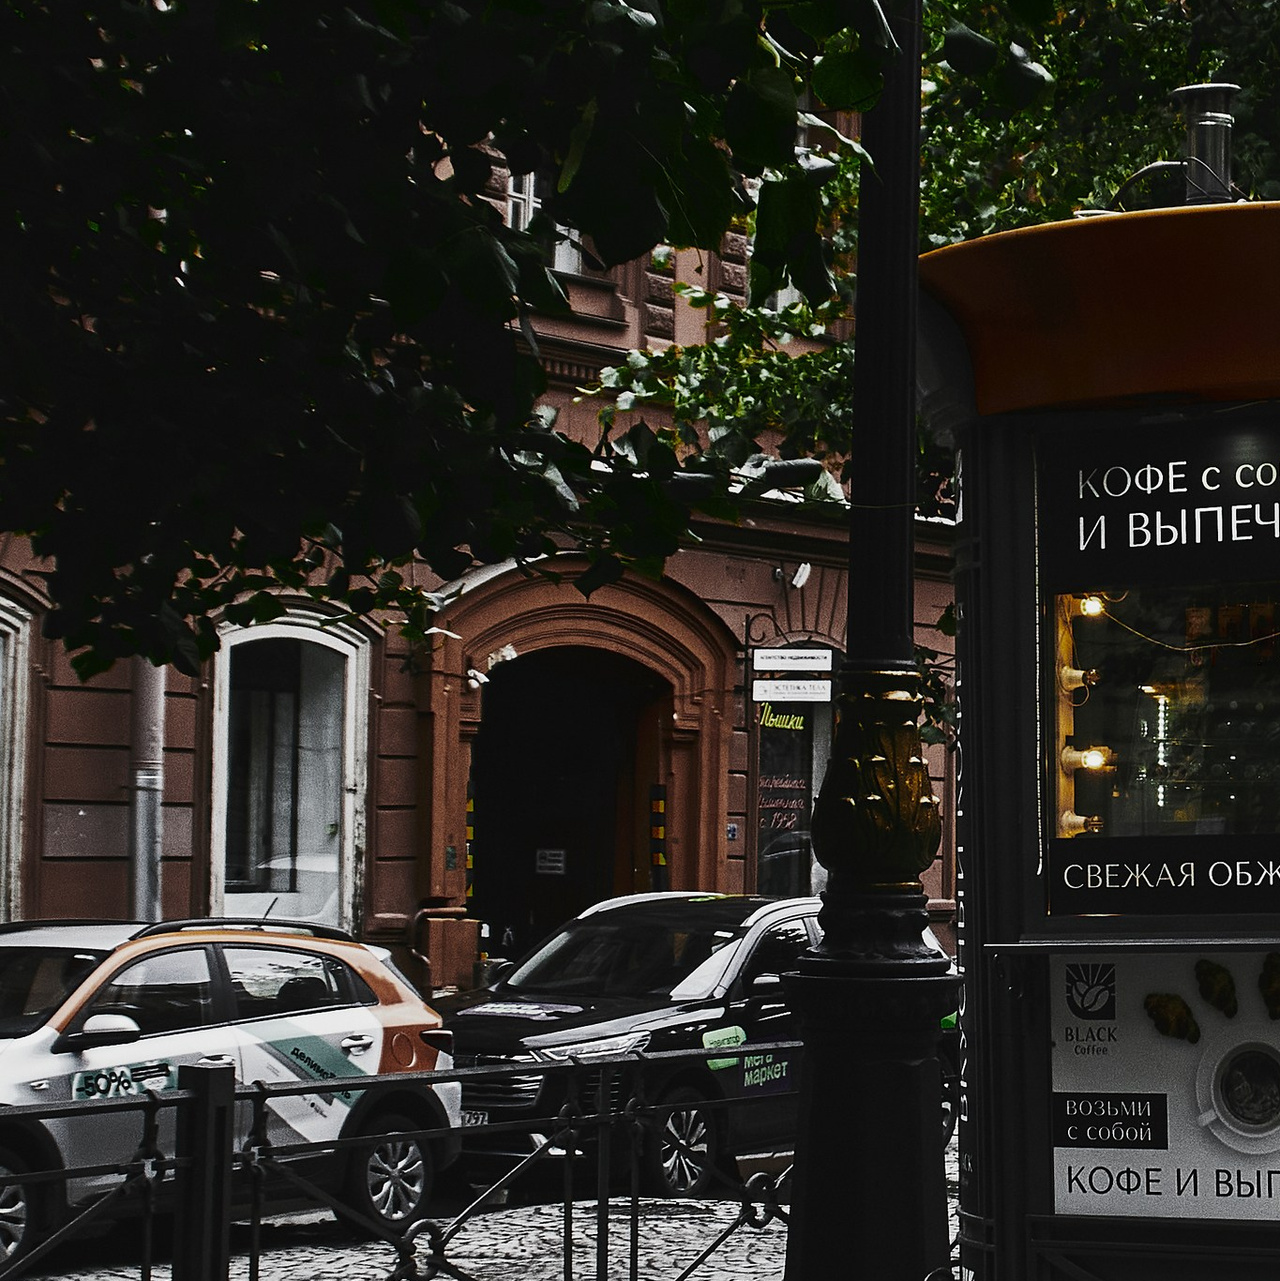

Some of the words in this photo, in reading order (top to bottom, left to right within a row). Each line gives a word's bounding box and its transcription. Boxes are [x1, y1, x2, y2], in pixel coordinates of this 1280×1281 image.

[1079, 461, 1187, 499] КОФЕ
[1201, 466, 1221, 490] с
[1079, 515, 1106, 550] И
[1064, 862, 1195, 889] СВЕЖАЯ
[1065, 1026, 1118, 1043] BLACK
[1074, 1044, 1108, 1056] Coffee
[76, 1071, 131, 1096] -50%
[1066, 1099, 1151, 1117] ВОЗЬМИ
[1067, 1125, 1078, 1141] с
[1086, 1121, 1152, 1142] собой
[1067, 1166, 1162, 1196] КОФЕ
[1176, 1168, 1198, 1197] И
